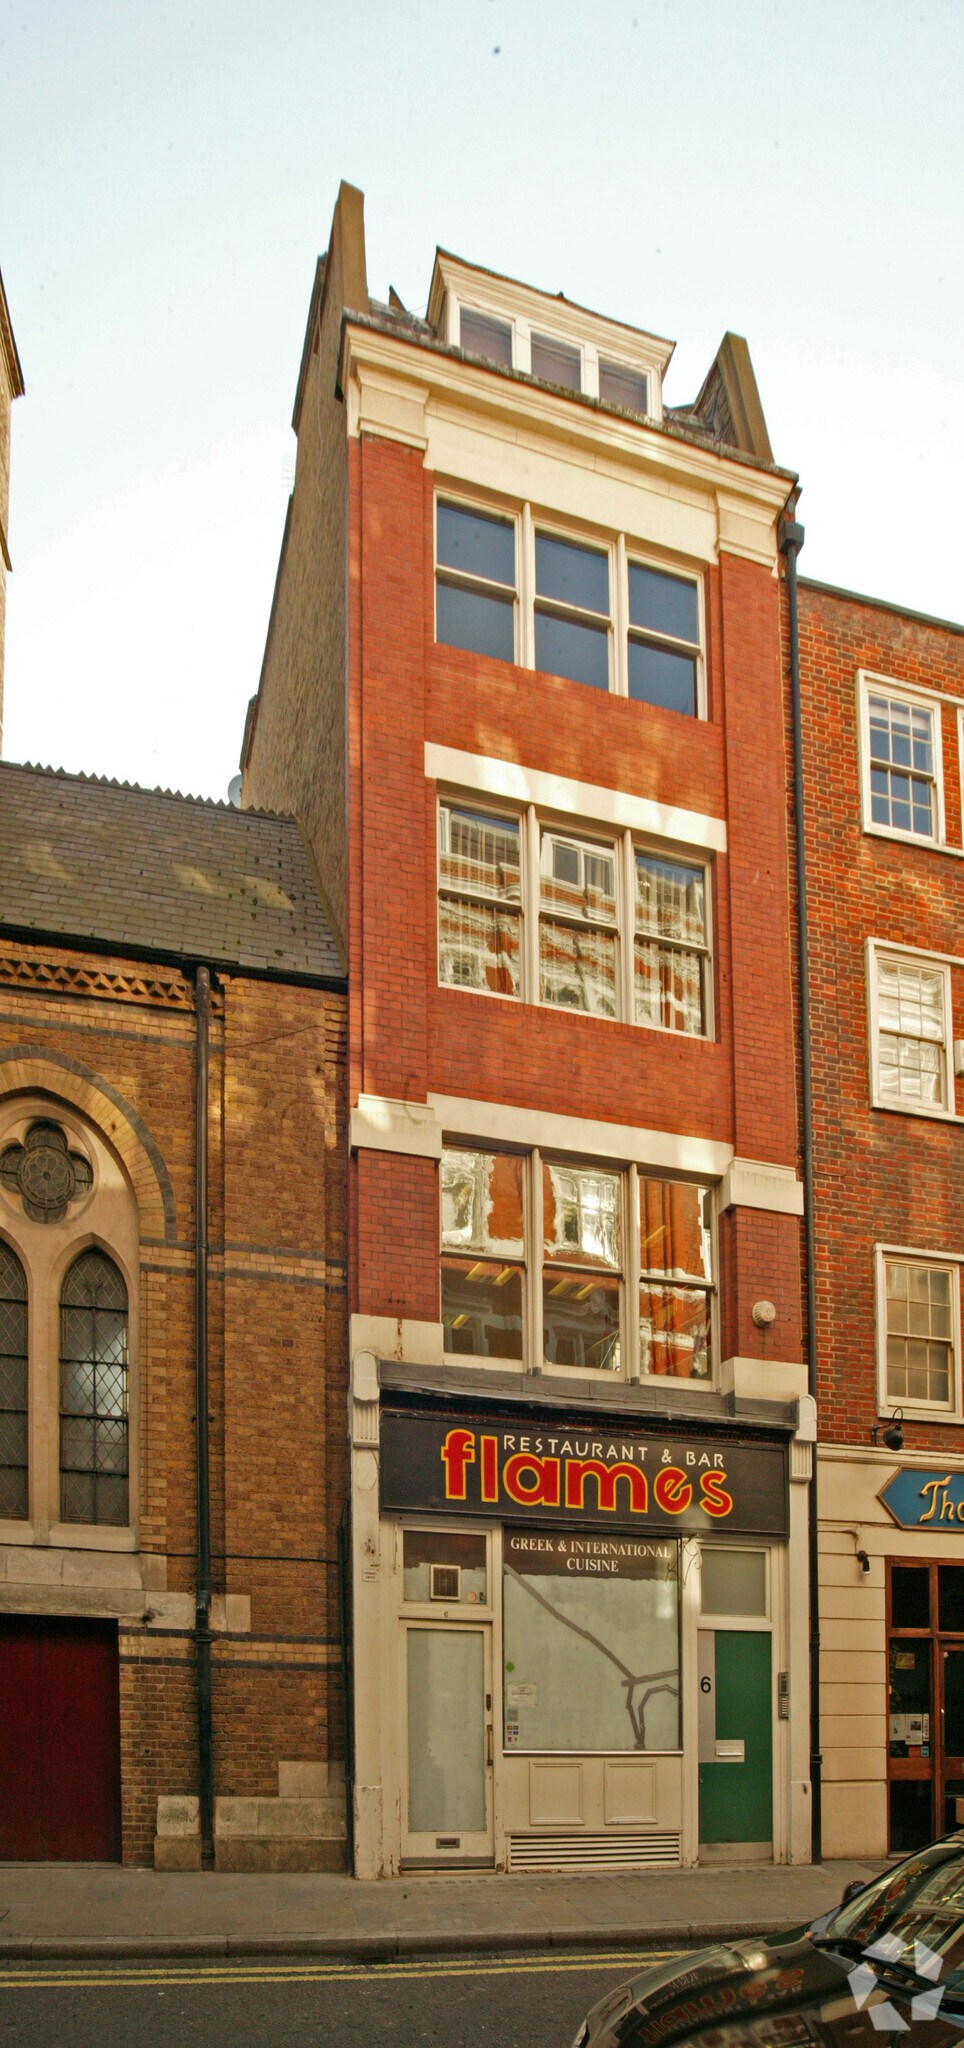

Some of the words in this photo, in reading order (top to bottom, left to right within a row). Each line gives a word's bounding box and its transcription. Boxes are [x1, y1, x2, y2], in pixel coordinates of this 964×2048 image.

[503, 1434, 648, 1462] RESTAURANT
[661, 1448, 672, 1464] &
[686, 1451, 725, 1468] BAR
[441, 1429, 733, 1518] flames
[510, 1537, 554, 1552] GREEK
[557, 1540, 567, 1553] &
[570, 1540, 672, 1559] INTERNATIONAL
[566, 1557, 619, 1573] CUISINE
[700, 1676, 712, 1694] 6
